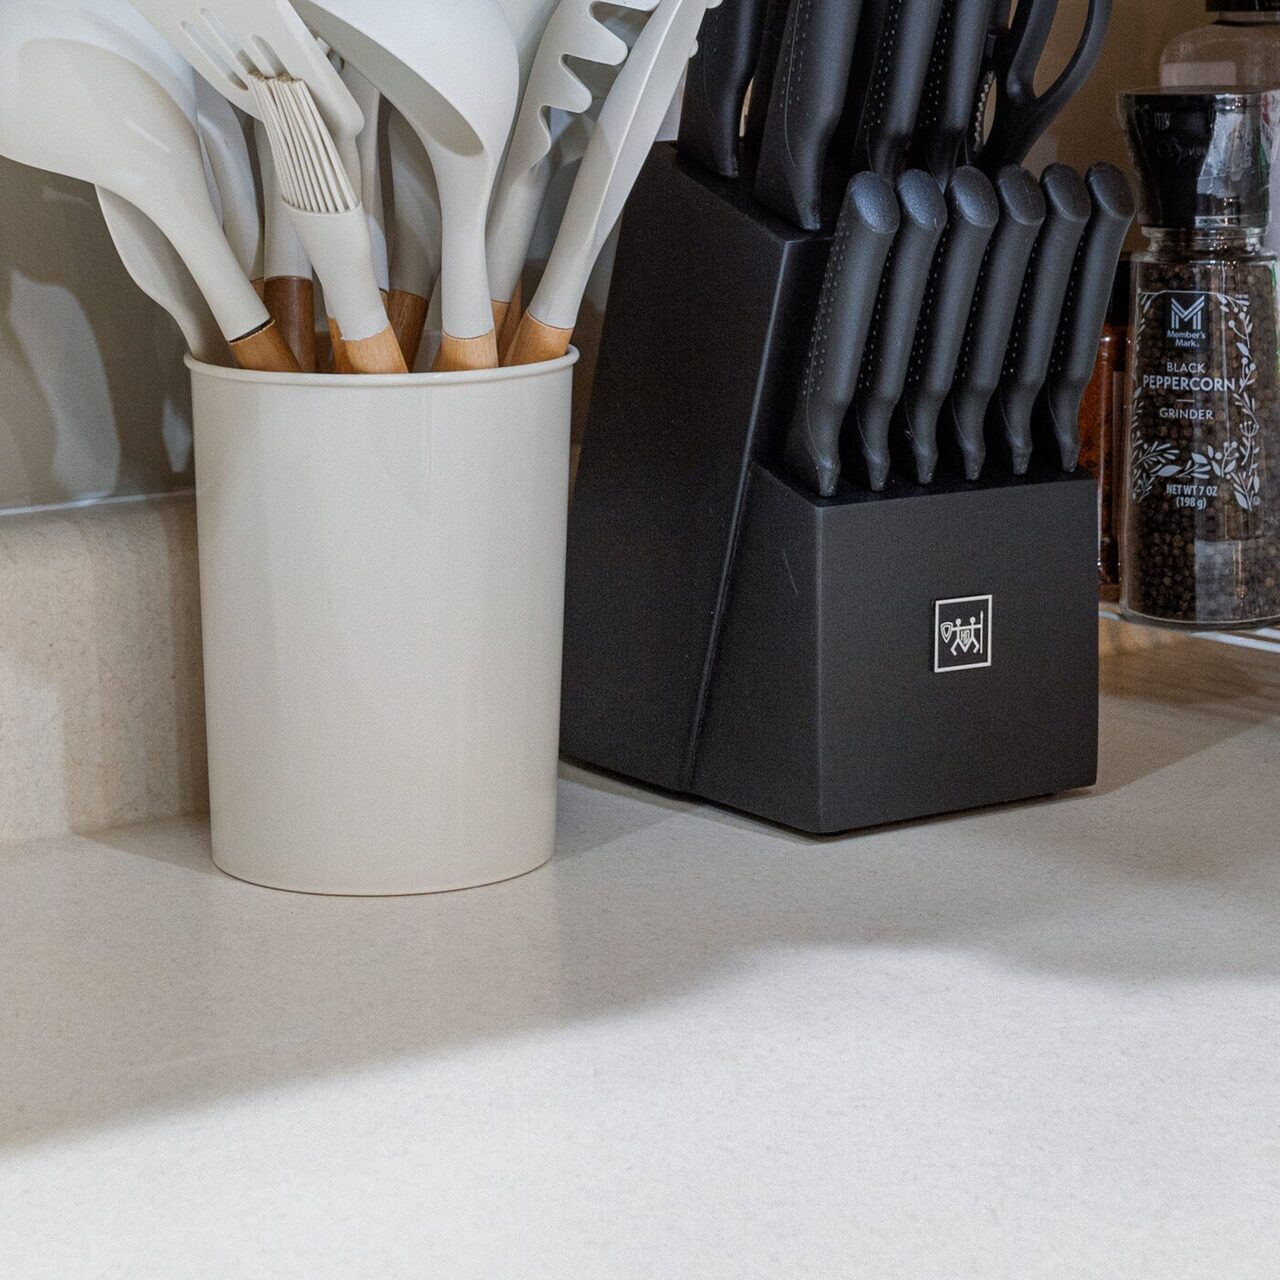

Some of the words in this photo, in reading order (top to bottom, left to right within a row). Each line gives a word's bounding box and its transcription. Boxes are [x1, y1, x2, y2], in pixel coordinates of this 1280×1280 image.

[1166, 329, 1206, 340] Member's
[1166, 362, 1206, 374] BLACK
[1142, 374, 1236, 391] PEPPERCORN
[1159, 407, 1214, 420] GRINDER
[1166, 484, 1182, 495] NET
[1183, 484, 1197, 496] WT
[1199, 485, 1205, 496] 7
[1206, 485, 1218, 497] OZ
[1176, 496, 1195, 508] (198
[1197, 497, 1207, 510] g)
